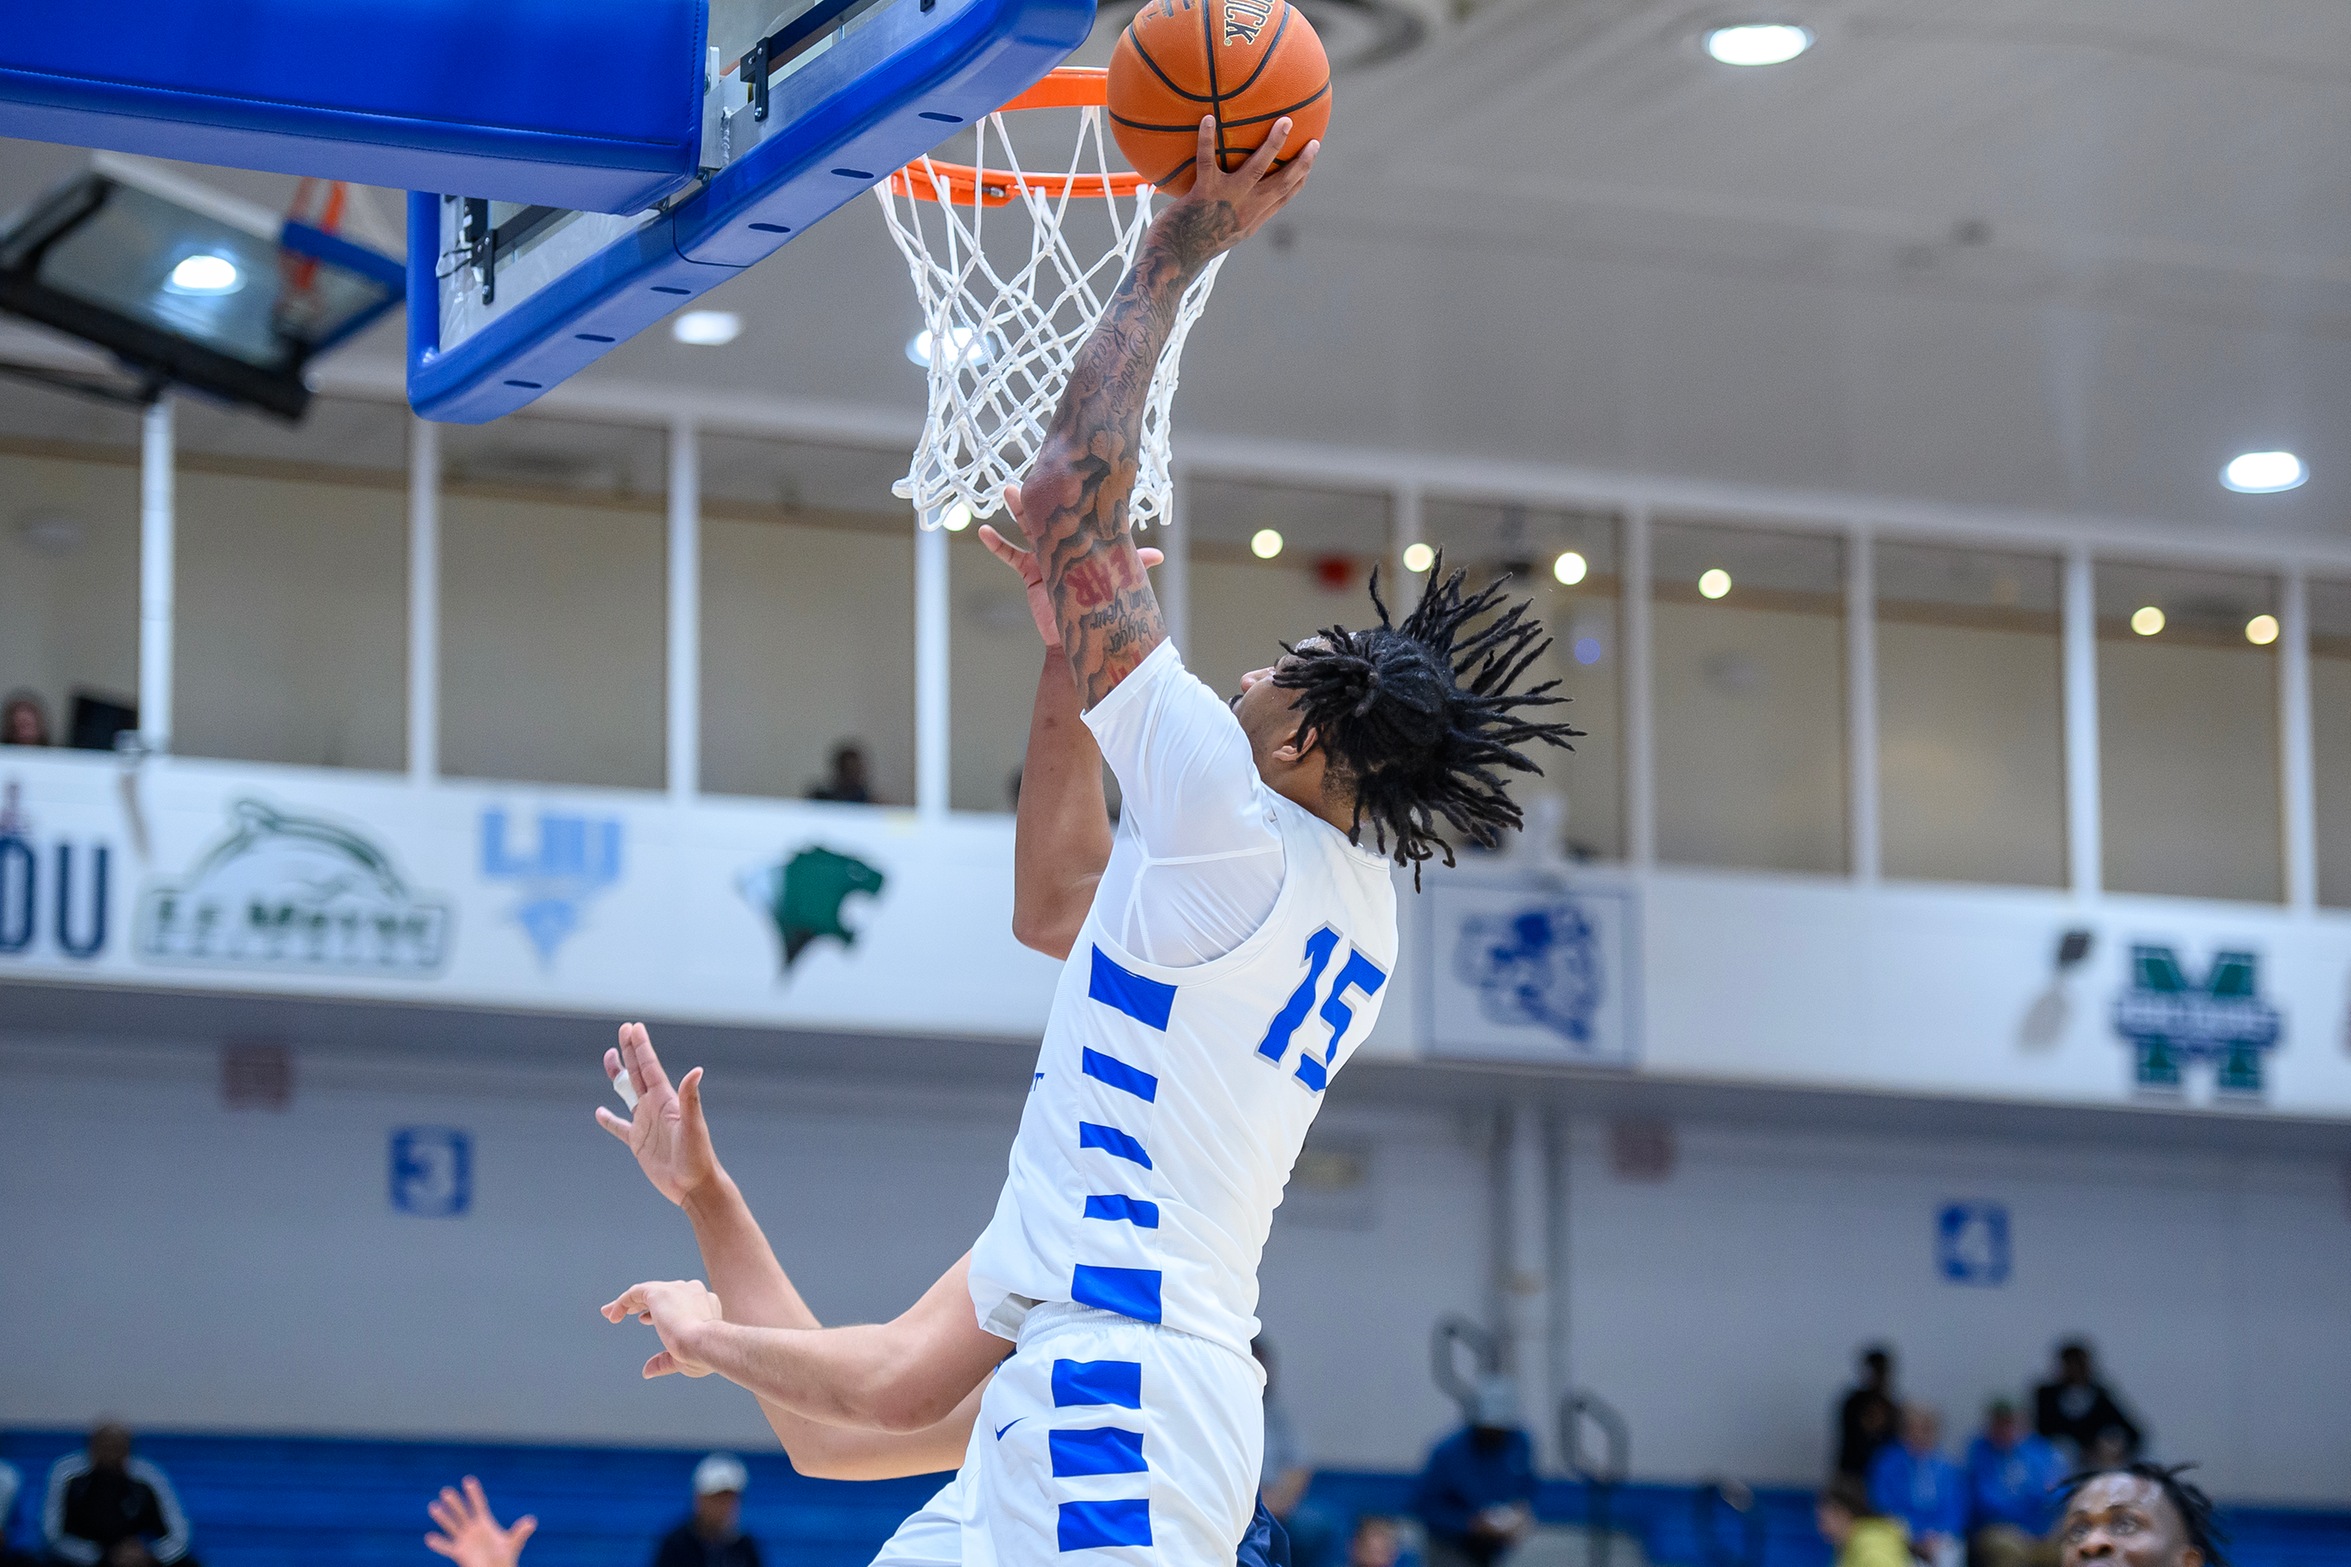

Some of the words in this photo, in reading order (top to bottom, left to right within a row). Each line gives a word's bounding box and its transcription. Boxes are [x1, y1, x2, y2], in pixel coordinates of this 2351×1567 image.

[1224, 0, 1275, 46] OCK
[1253, 919, 1389, 1099] 15
[406, 1140, 454, 1208] 3
